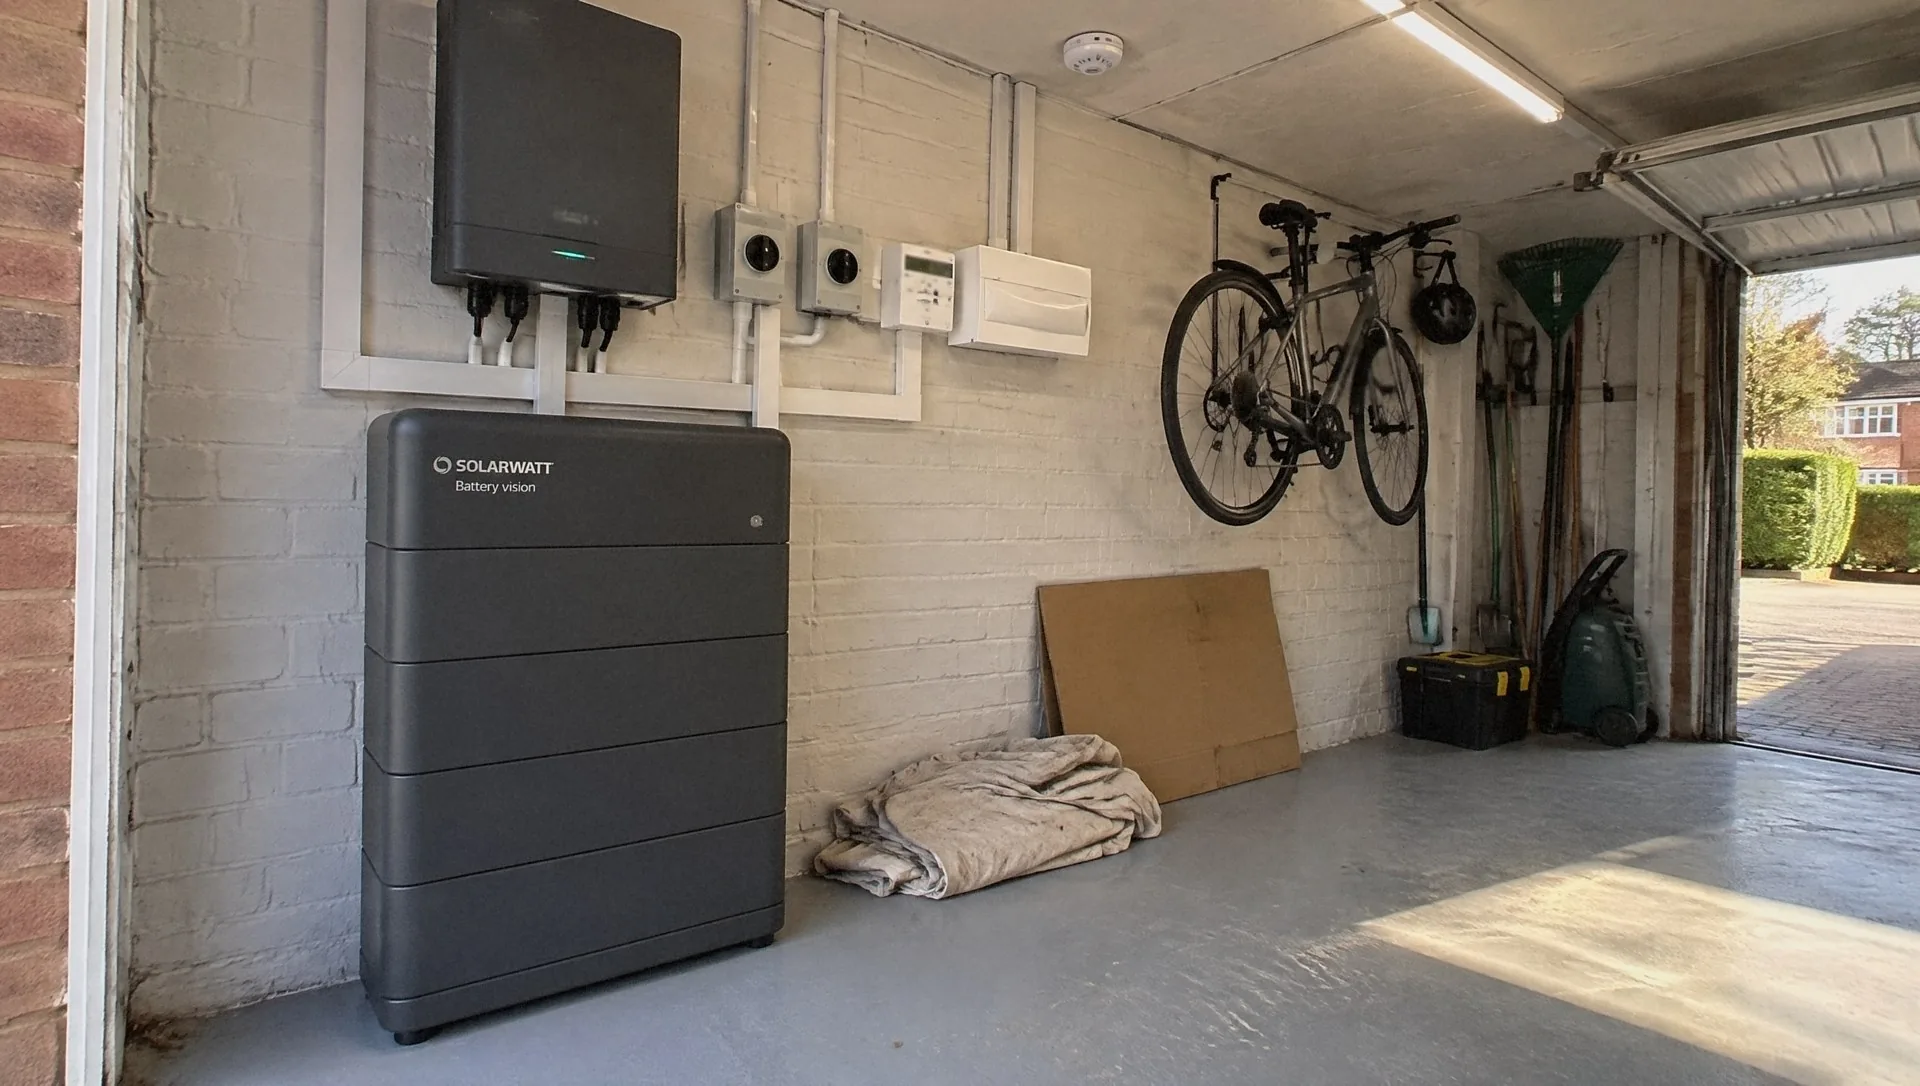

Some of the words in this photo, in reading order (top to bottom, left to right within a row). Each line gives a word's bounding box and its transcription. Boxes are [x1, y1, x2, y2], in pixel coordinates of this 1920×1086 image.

[456, 459, 554, 475] SOLARWATT
[455, 480, 499, 495] Battery
[502, 481, 536, 493] vision
